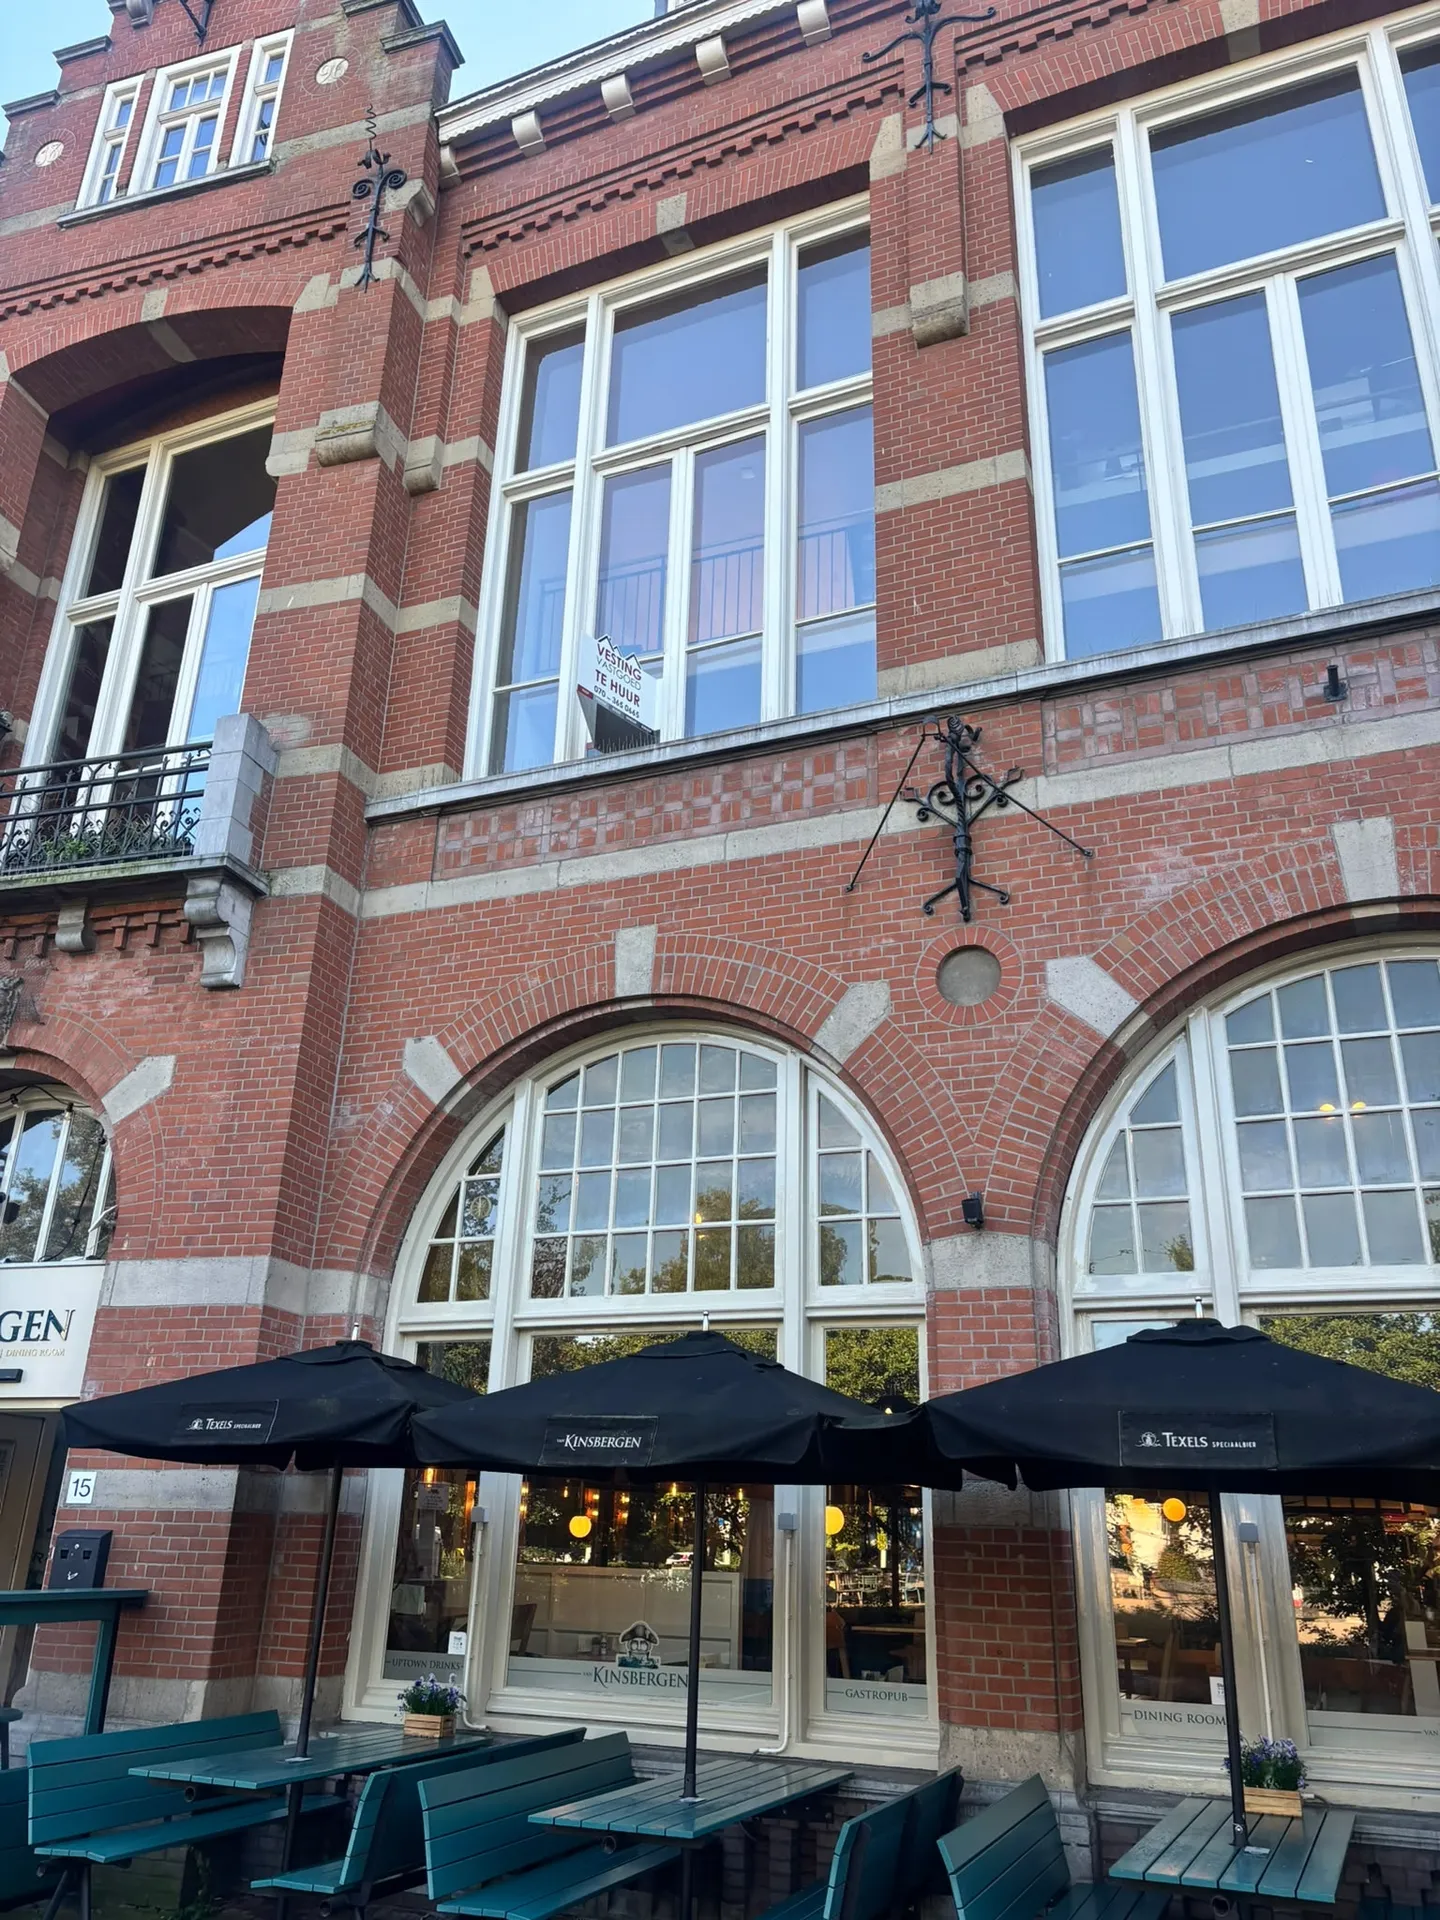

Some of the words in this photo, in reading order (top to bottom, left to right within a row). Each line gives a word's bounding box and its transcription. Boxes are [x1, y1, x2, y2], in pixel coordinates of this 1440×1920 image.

[597, 643, 642, 680] VESTING
[596, 657, 641, 691] VASTGOED
[594, 685, 606, 698] 070
[595, 669, 607, 687] TE
[610, 681, 640, 707] HUUR
[6, 1348, 38, 1357] DINING
[39, 1348, 66, 1357] ROOM
[564, 1433, 642, 1452] KINSBERGEN
[72, 1478, 92, 1498] 15
[392, 1658, 428, 1669] UPTOWN
[429, 1661, 460, 1671] DRINKS
[593, 1665, 688, 1689] KINSBERGEN
[845, 1688, 909, 1702] GASTROPUB
[1134, 1709, 1182, 1723] DINING
[1187, 1713, 1226, 1726] ROOM
[1423, 1728, 1439, 1737] VAN
